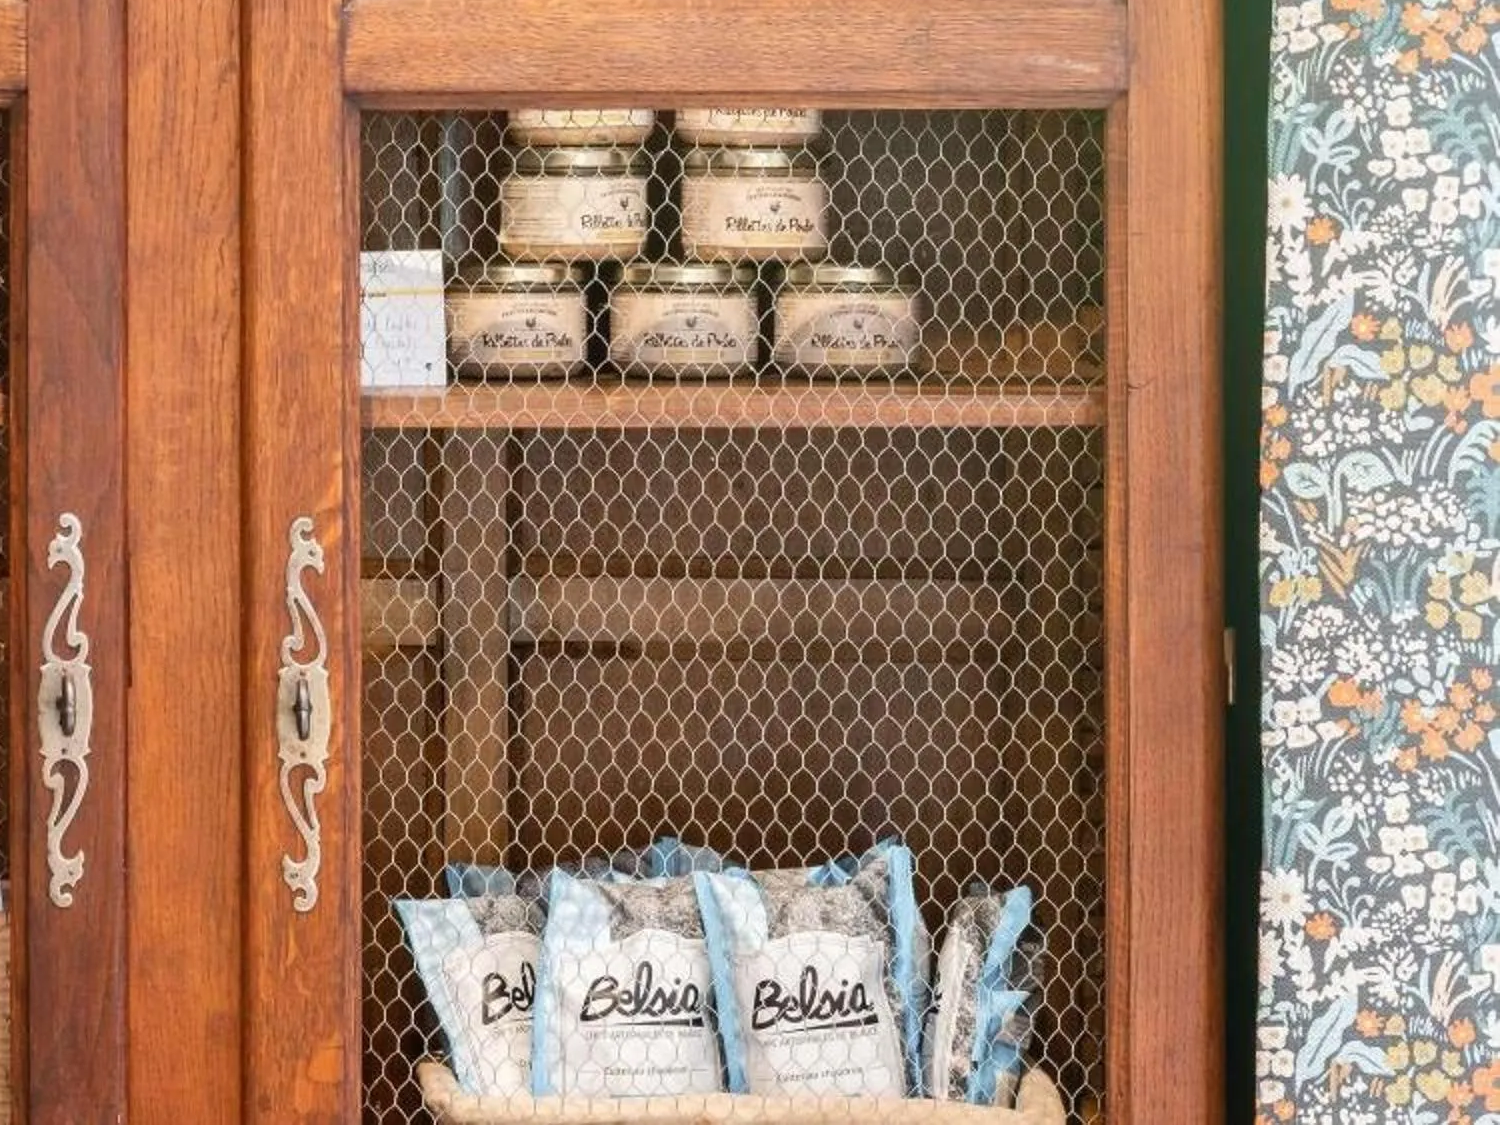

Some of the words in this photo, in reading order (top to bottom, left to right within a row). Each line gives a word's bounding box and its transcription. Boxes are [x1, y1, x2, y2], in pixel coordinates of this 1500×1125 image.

[482, 961, 536, 1026] Bel
[580, 960, 701, 1022] Belsia
[752, 965, 874, 1030] Belsia
